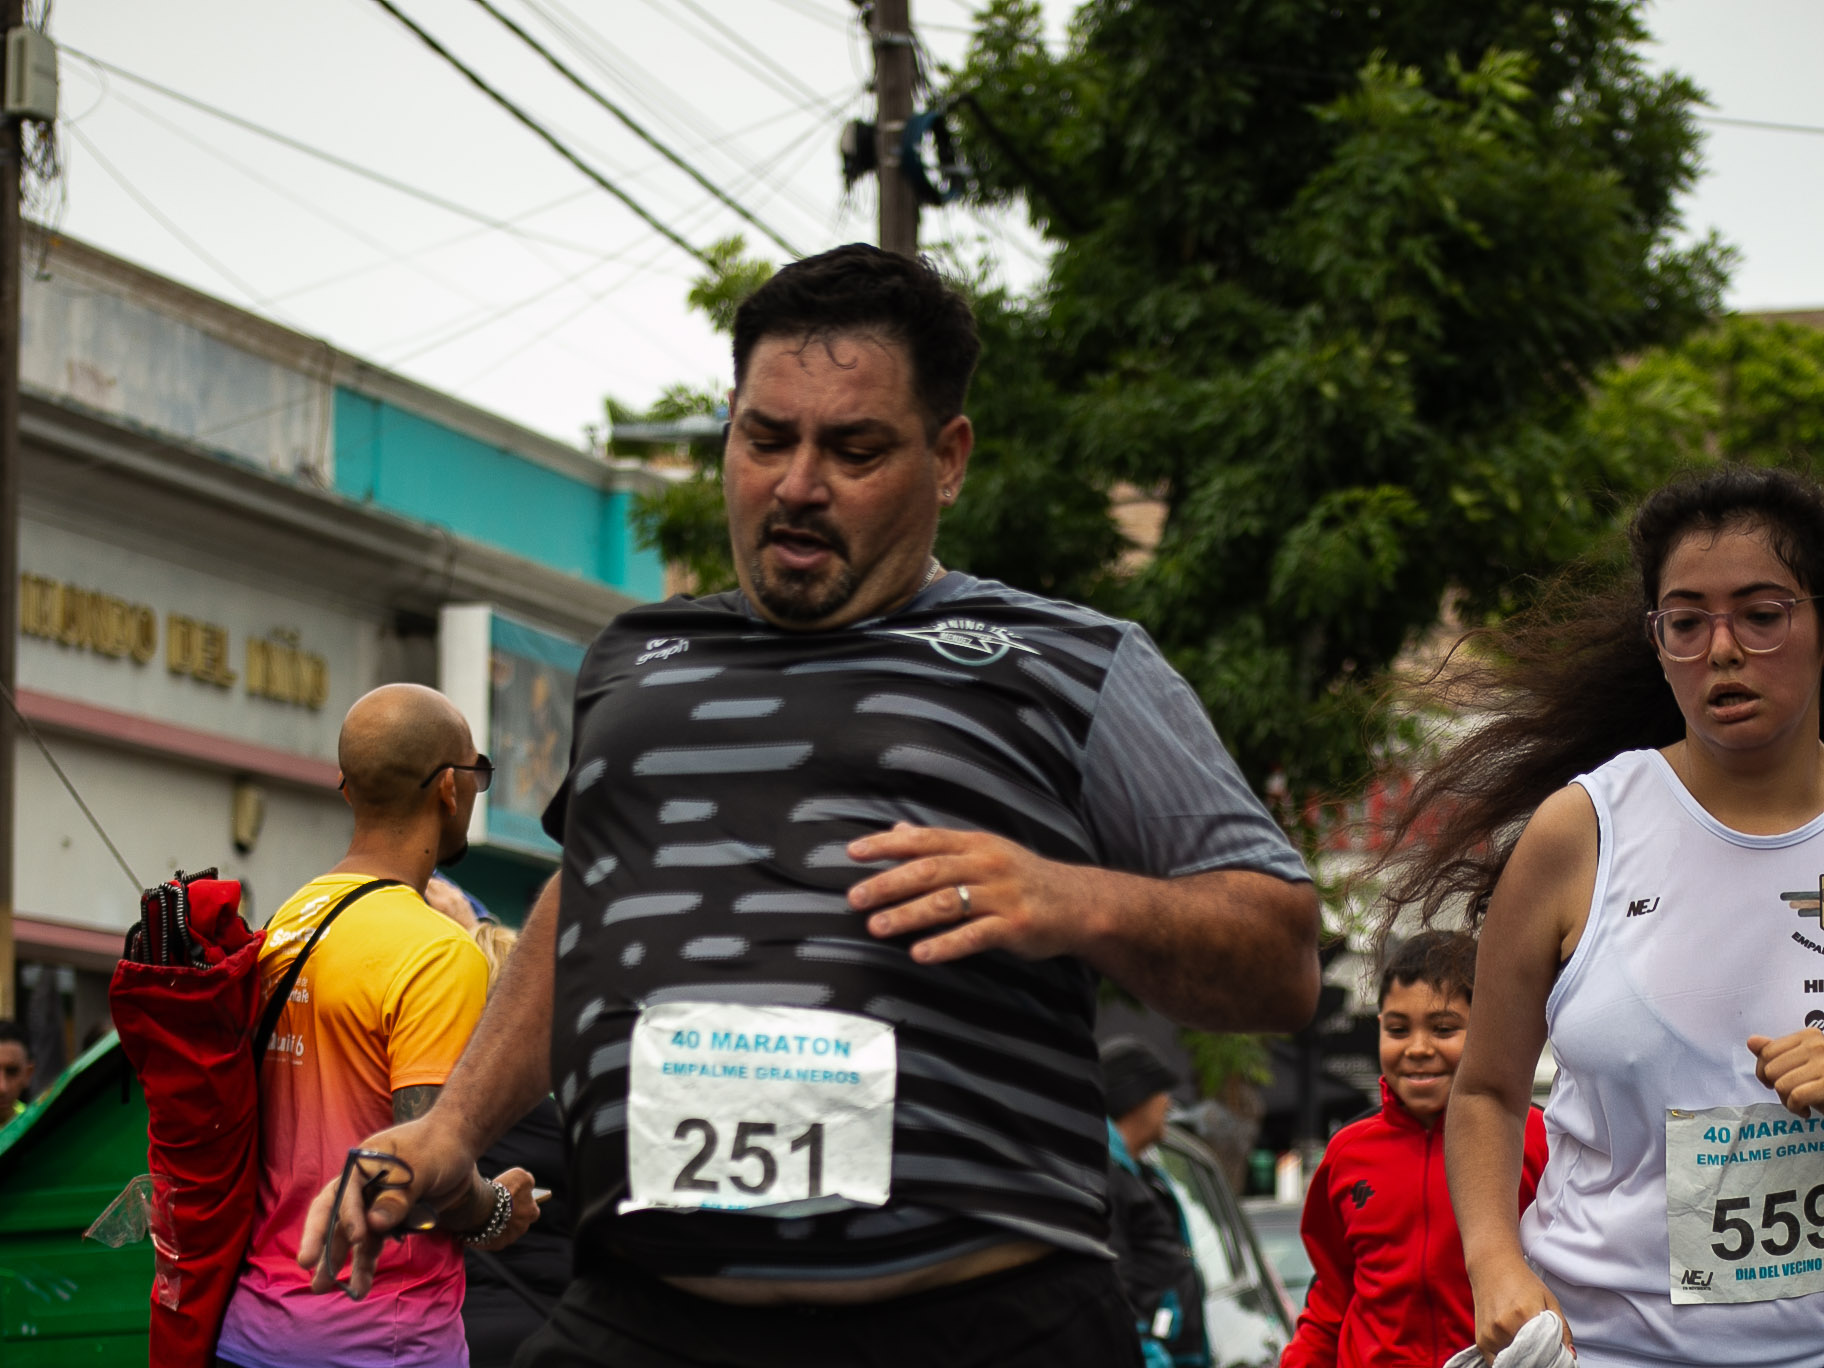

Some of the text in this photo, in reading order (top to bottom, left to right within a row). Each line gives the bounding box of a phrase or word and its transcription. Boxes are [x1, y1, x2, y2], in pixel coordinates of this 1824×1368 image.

[166, 612, 237, 690] DEL
[671, 1030, 851, 1058] 40 MARATON
[662, 1061, 861, 1085] EMPALME GRANEROS
[1703, 1117, 1824, 1144] 40 MARAT
[673, 1118, 825, 1197] 251
[1697, 1148, 1772, 1166] EMPALME
[1711, 1183, 1824, 1261] 559
[1735, 1257, 1823, 1281] DIA DEL VECINO
